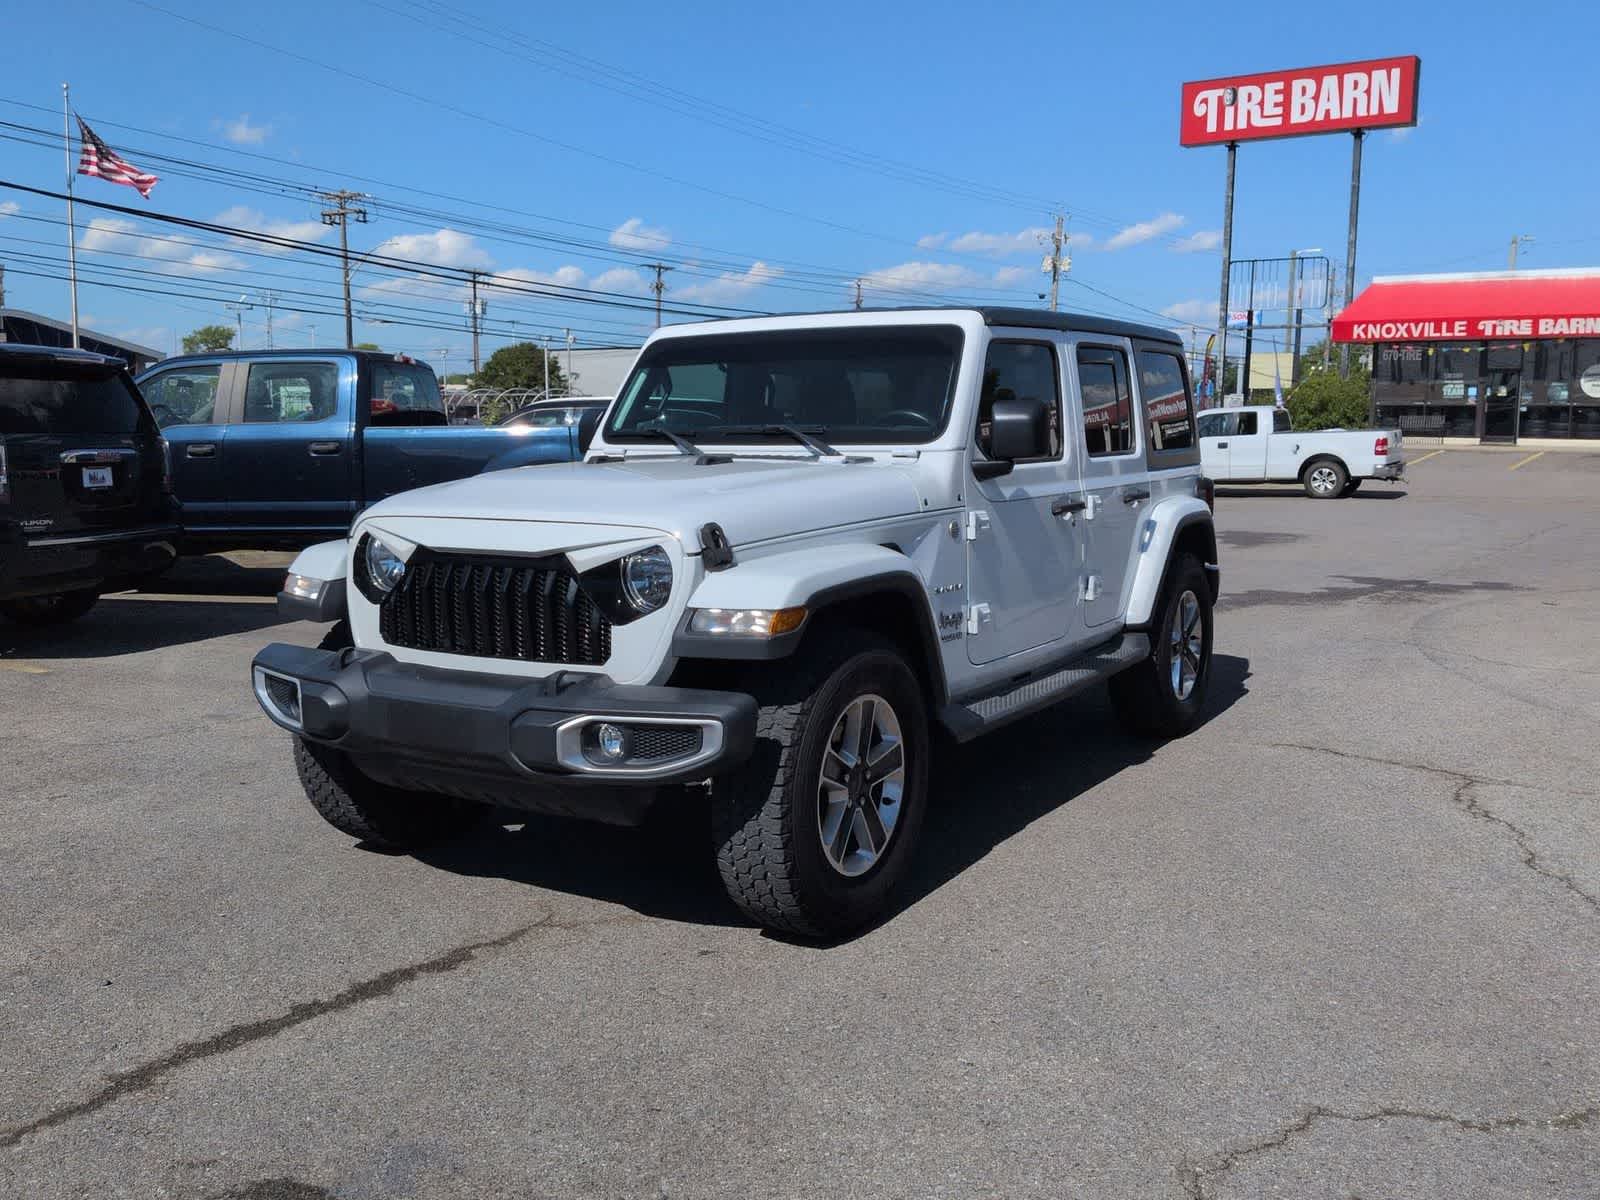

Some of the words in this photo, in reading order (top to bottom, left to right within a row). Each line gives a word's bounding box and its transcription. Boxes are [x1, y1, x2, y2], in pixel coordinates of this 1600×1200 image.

[1290, 67, 1401, 124] BARN
[1352, 320, 1467, 339] KNOXVILLE
[1538, 316, 1600, 335] BARN
